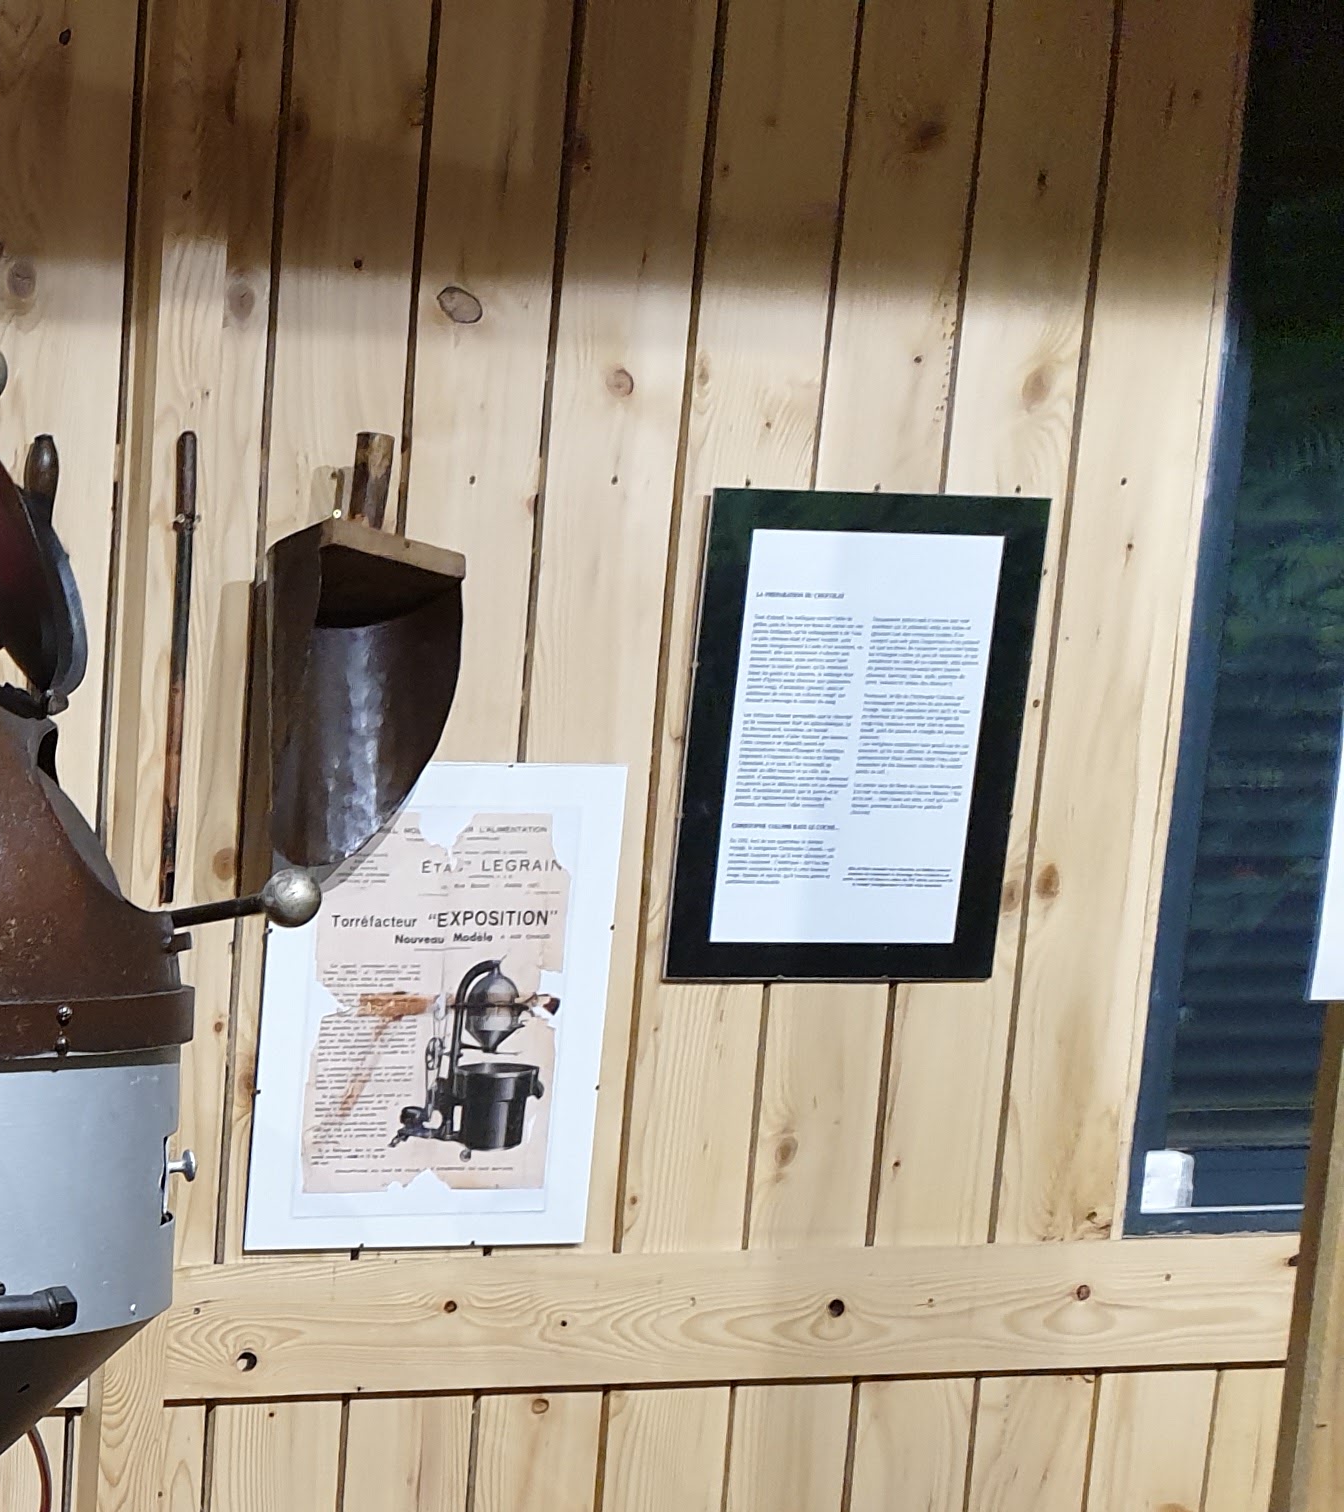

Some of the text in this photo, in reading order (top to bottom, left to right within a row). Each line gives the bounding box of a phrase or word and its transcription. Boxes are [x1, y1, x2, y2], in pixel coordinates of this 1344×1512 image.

[481, 859, 563, 872] LEGRAIN
[331, 910, 558, 928] Torréfacteur "EXPOSITION"
[394, 934, 445, 944] Nouveau
[453, 932, 493, 942] Modèle
